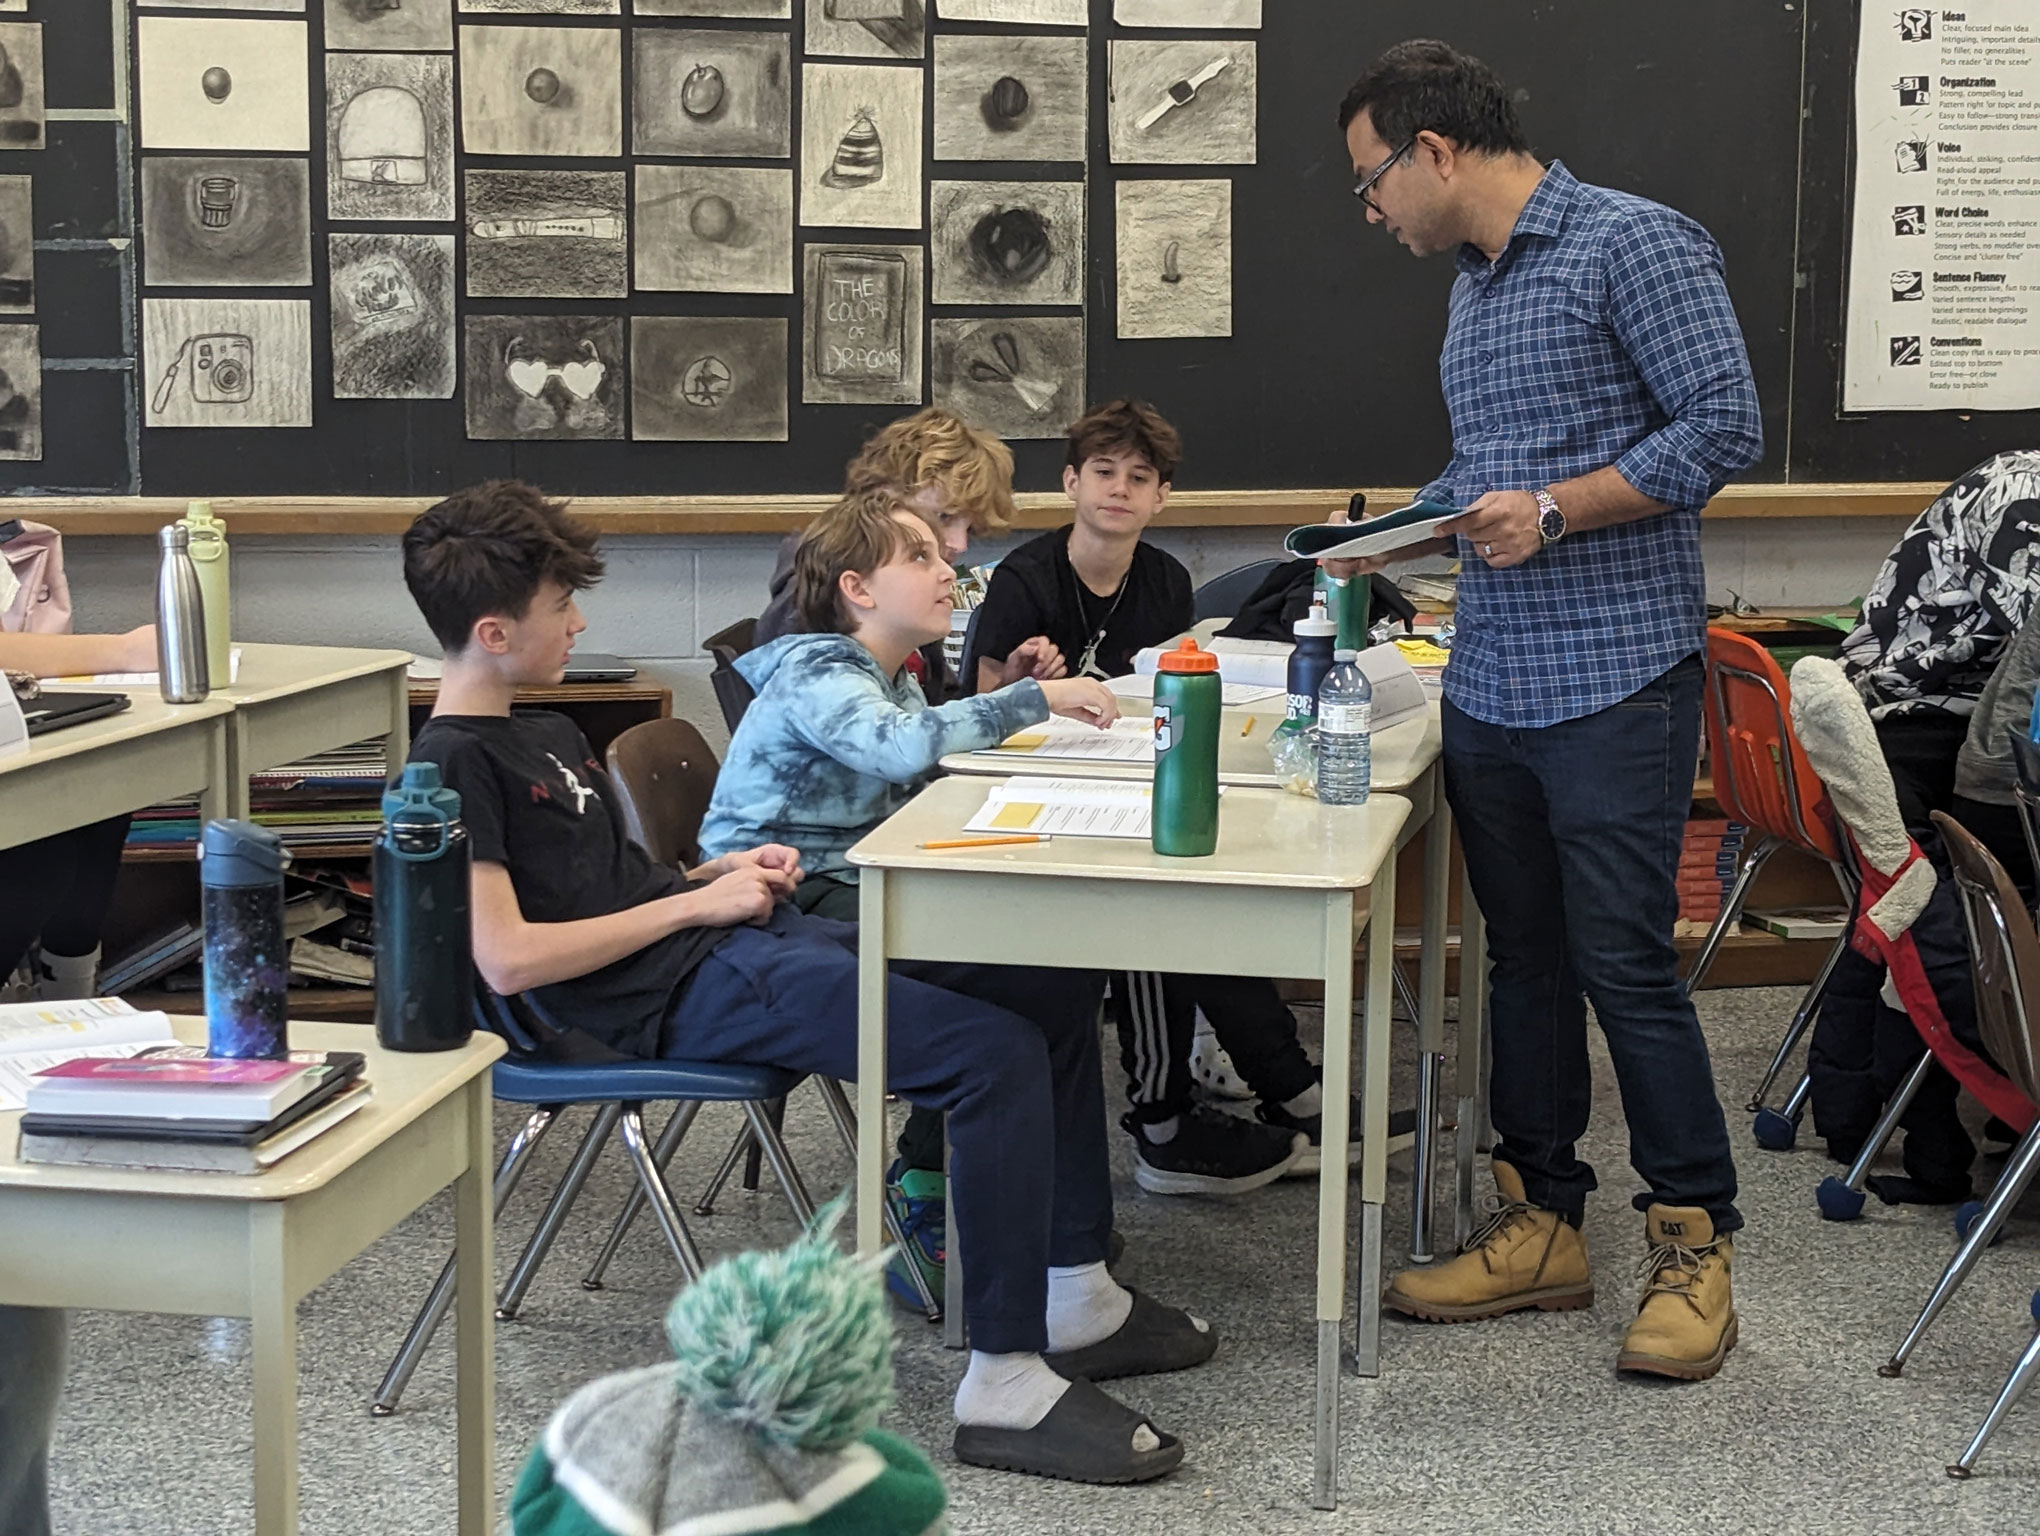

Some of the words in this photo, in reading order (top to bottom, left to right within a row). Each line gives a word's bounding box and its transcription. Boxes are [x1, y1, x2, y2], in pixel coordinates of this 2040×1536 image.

[1942, 10, 1966, 21] Ideas
[1942, 24, 1962, 32] Clear,
[1965, 24, 1992, 32] focused
[1994, 24, 2012, 32] main
[2014, 24, 2029, 32] idea
[1942, 36, 1979, 44] Intriguing,
[1981, 36, 2016, 44] important
[1954, 47, 1972, 55] filler,
[1985, 47, 2025, 55] generalities
[1940, 76, 1996, 89] Organization
[1940, 90, 1965, 98] Strong,
[1968, 90, 2006, 98] compelling
[1967, 101, 1984, 109] right
[1998, 101, 2015, 109] topic
[1939, 112, 1955, 120] Easy
[1937, 142, 1961, 152] Voice
[1977, 156, 2005, 164] striking,
[1937, 178, 1955, 186] Right
[1935, 207, 1959, 218] Word
[1962, 207, 1989, 218] Choice
[1935, 220, 1955, 228] Clear,
[1934, 242, 1957, 251] Strong
[1933, 272, 1971, 282] Sentence
[1974, 272, 2006, 283] Fluency
[833, 278, 874, 300] THE
[827, 300, 885, 322] COLOR
[1996, 317, 2027, 325] dialogue
[848, 326, 866, 339] OF
[1930, 336, 1982, 347] Conventions
[826, 345, 900, 375] DRAGONS
[1930, 382, 1950, 390] Ready
[1962, 382, 1989, 390] publish
[1153, 704, 1172, 752] G
[1660, 1220, 1683, 1236] CAT
